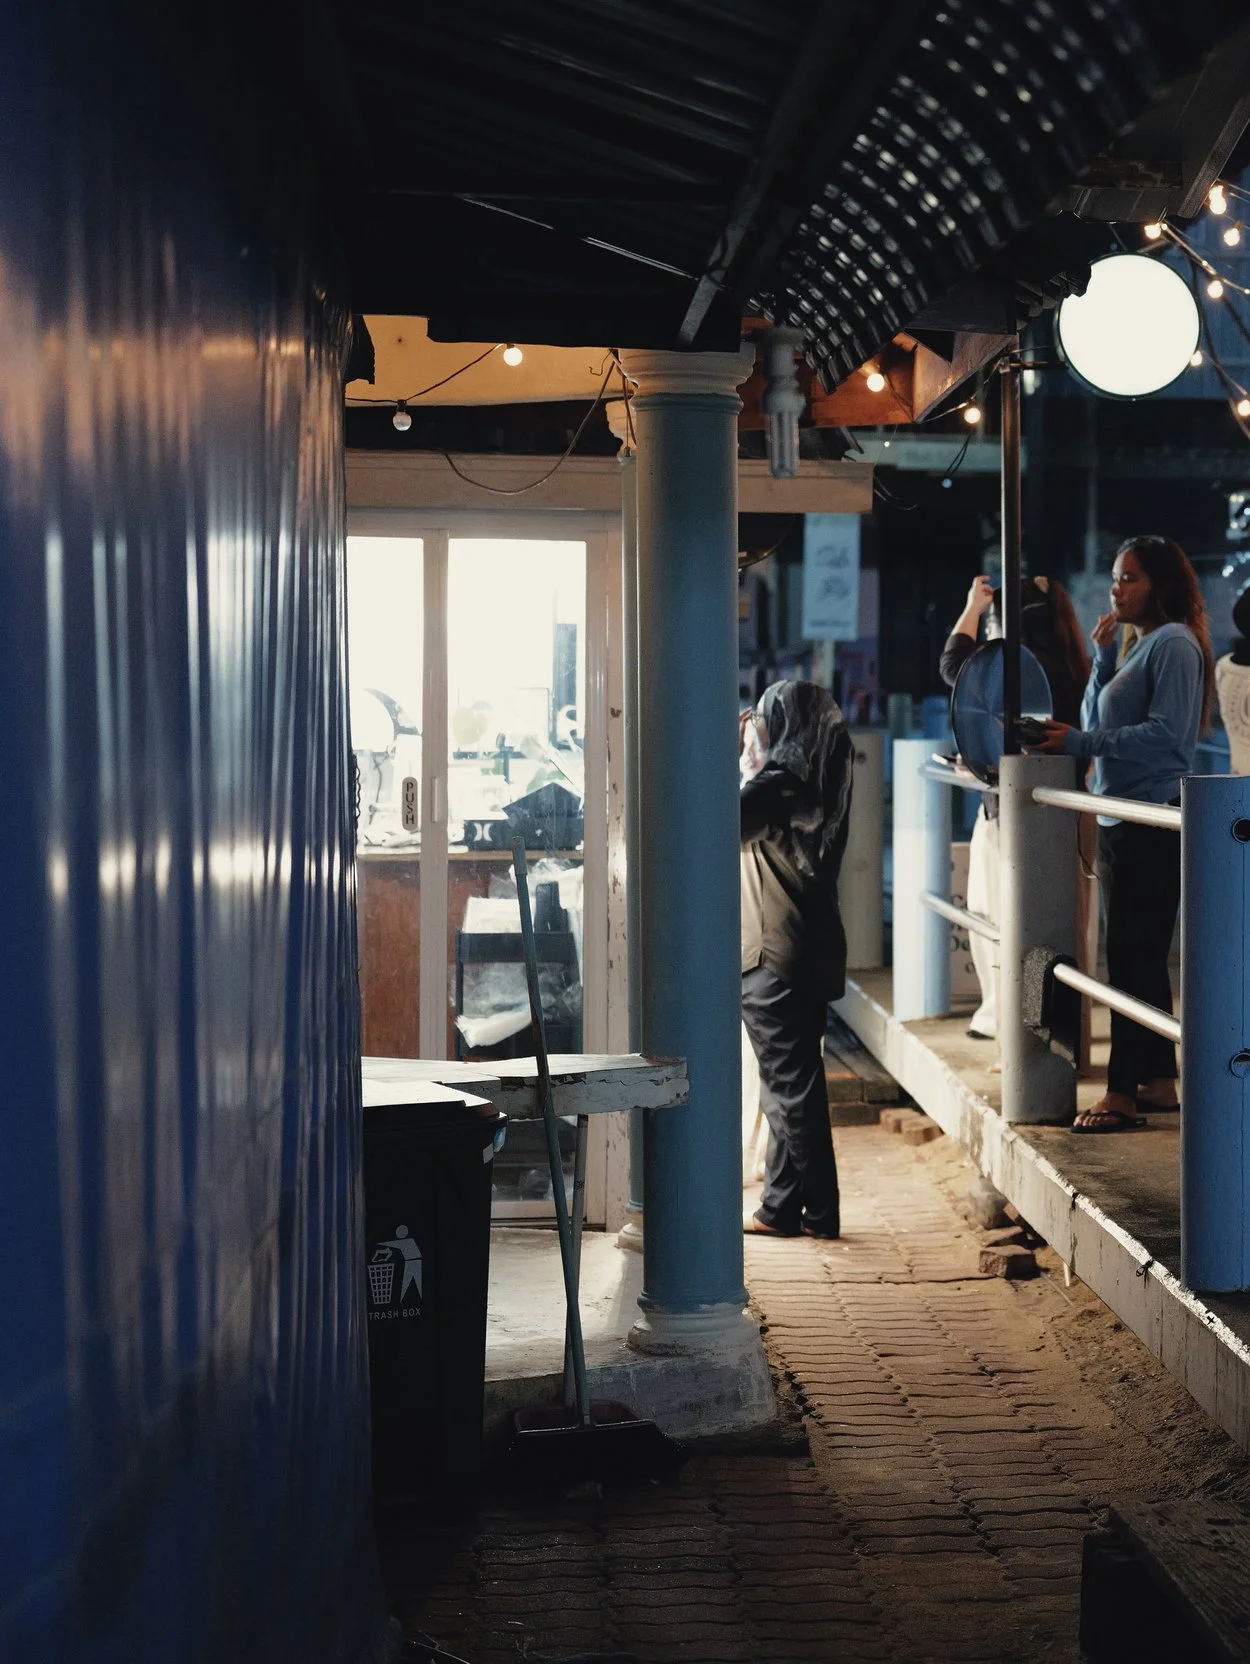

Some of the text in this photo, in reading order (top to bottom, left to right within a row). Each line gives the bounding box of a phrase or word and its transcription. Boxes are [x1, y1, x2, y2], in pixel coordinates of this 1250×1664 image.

[406, 782, 414, 824] PUSH
[368, 1307, 421, 1321] TRASH BOX
